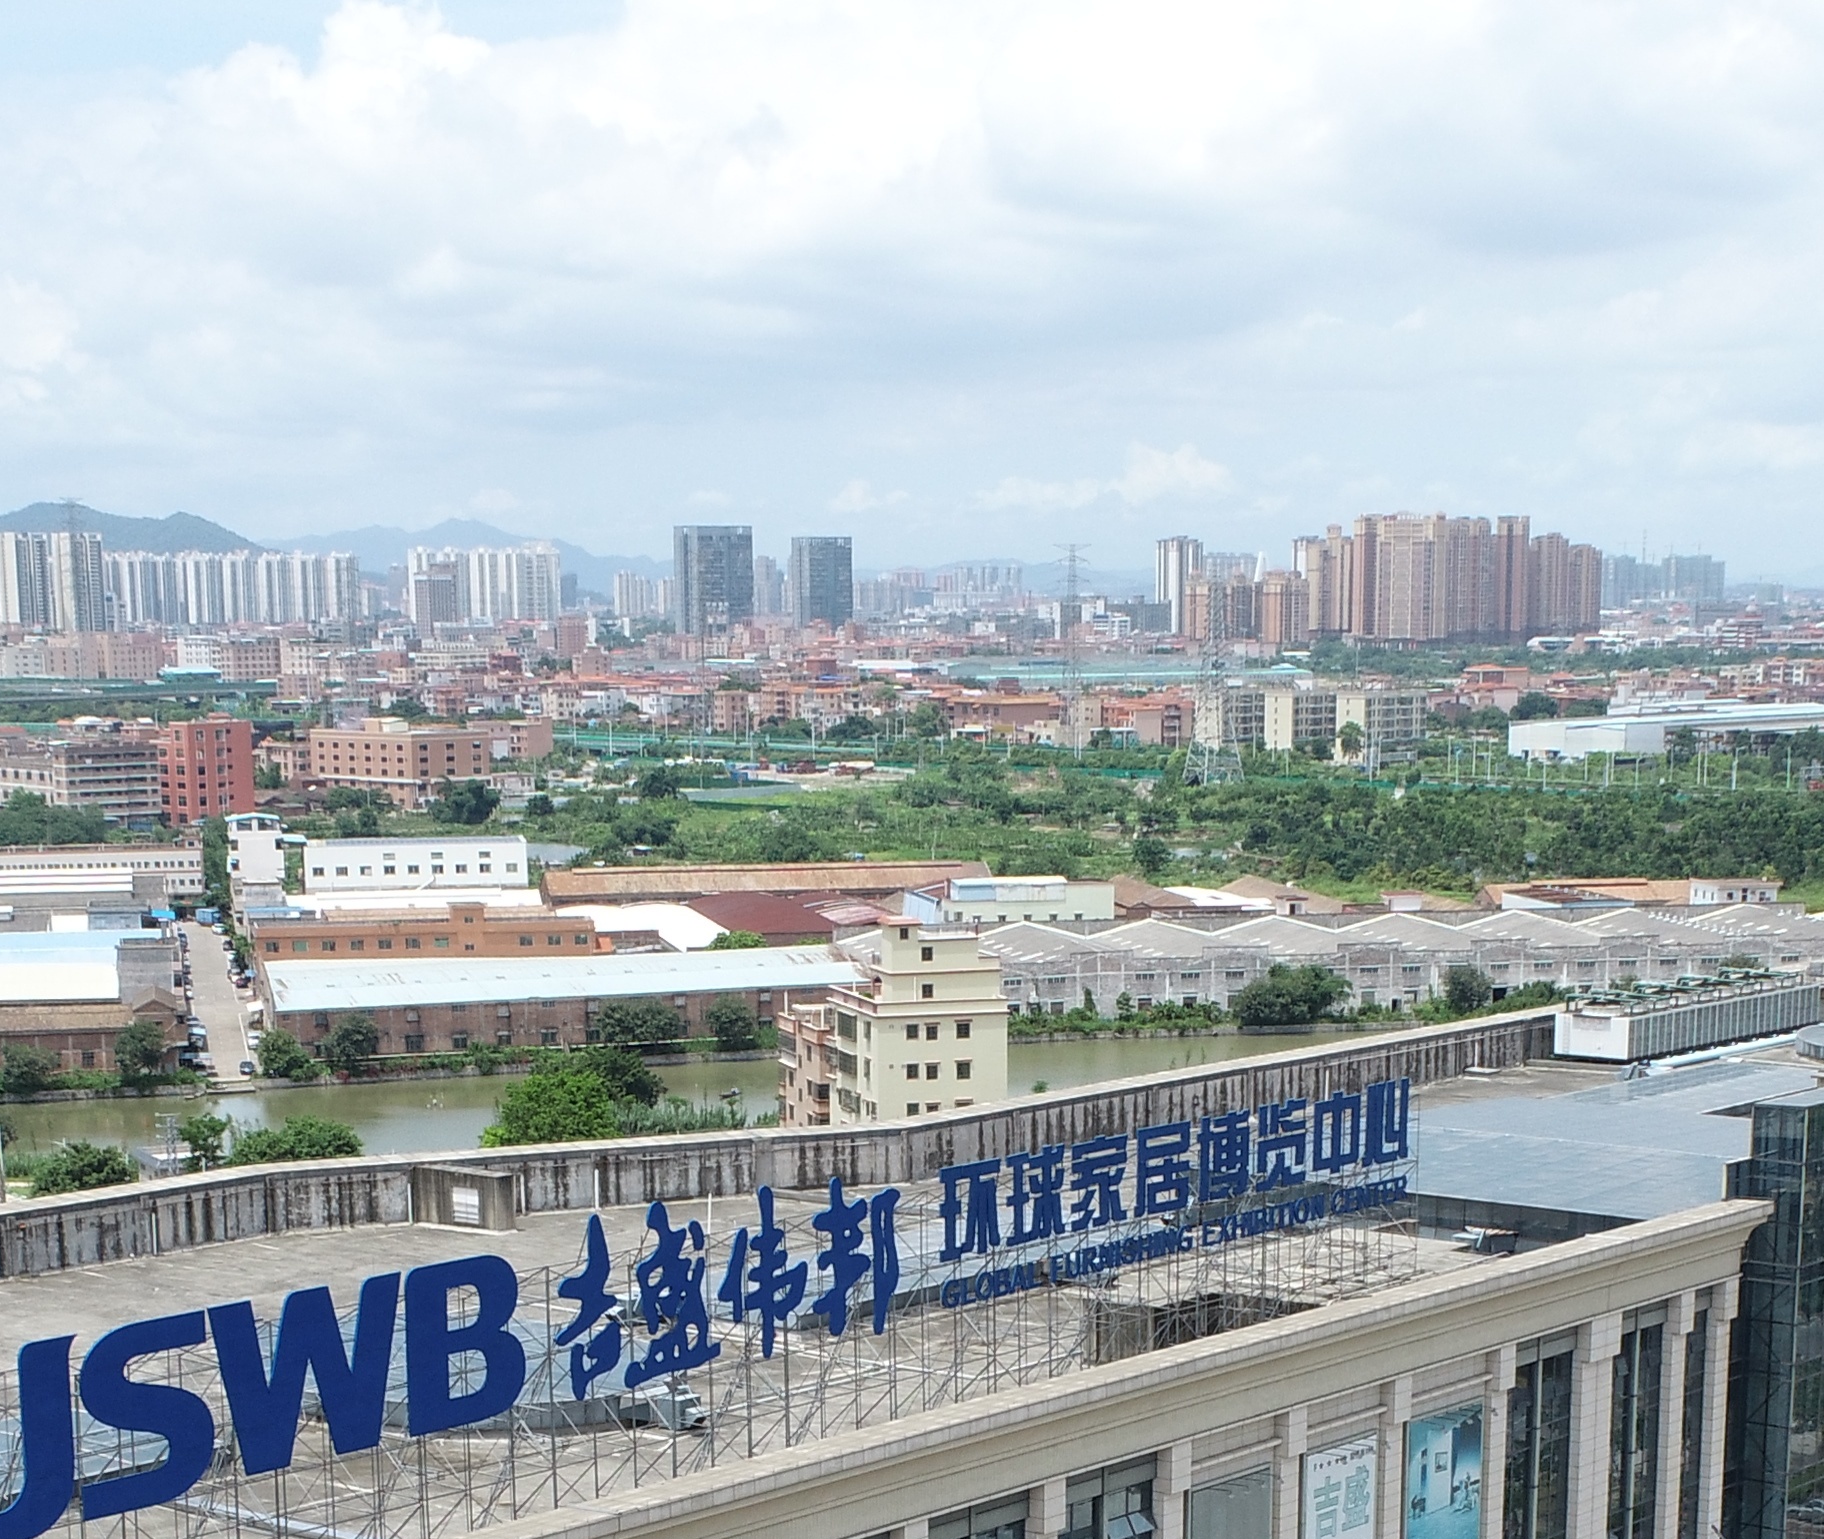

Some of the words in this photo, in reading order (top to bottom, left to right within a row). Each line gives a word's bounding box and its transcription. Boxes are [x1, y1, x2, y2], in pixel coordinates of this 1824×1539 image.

[939, 1077, 1410, 1263] 环球家居博览中心
[940, 1262, 1044, 1309] GLOBAL
[1050, 1226, 1194, 1281] FURNISHING
[1201, 1193, 1324, 1247] EXHIBITION
[1331, 1175, 1408, 1217] CENTER
[556, 1174, 901, 1401] 吉盛伟邦
